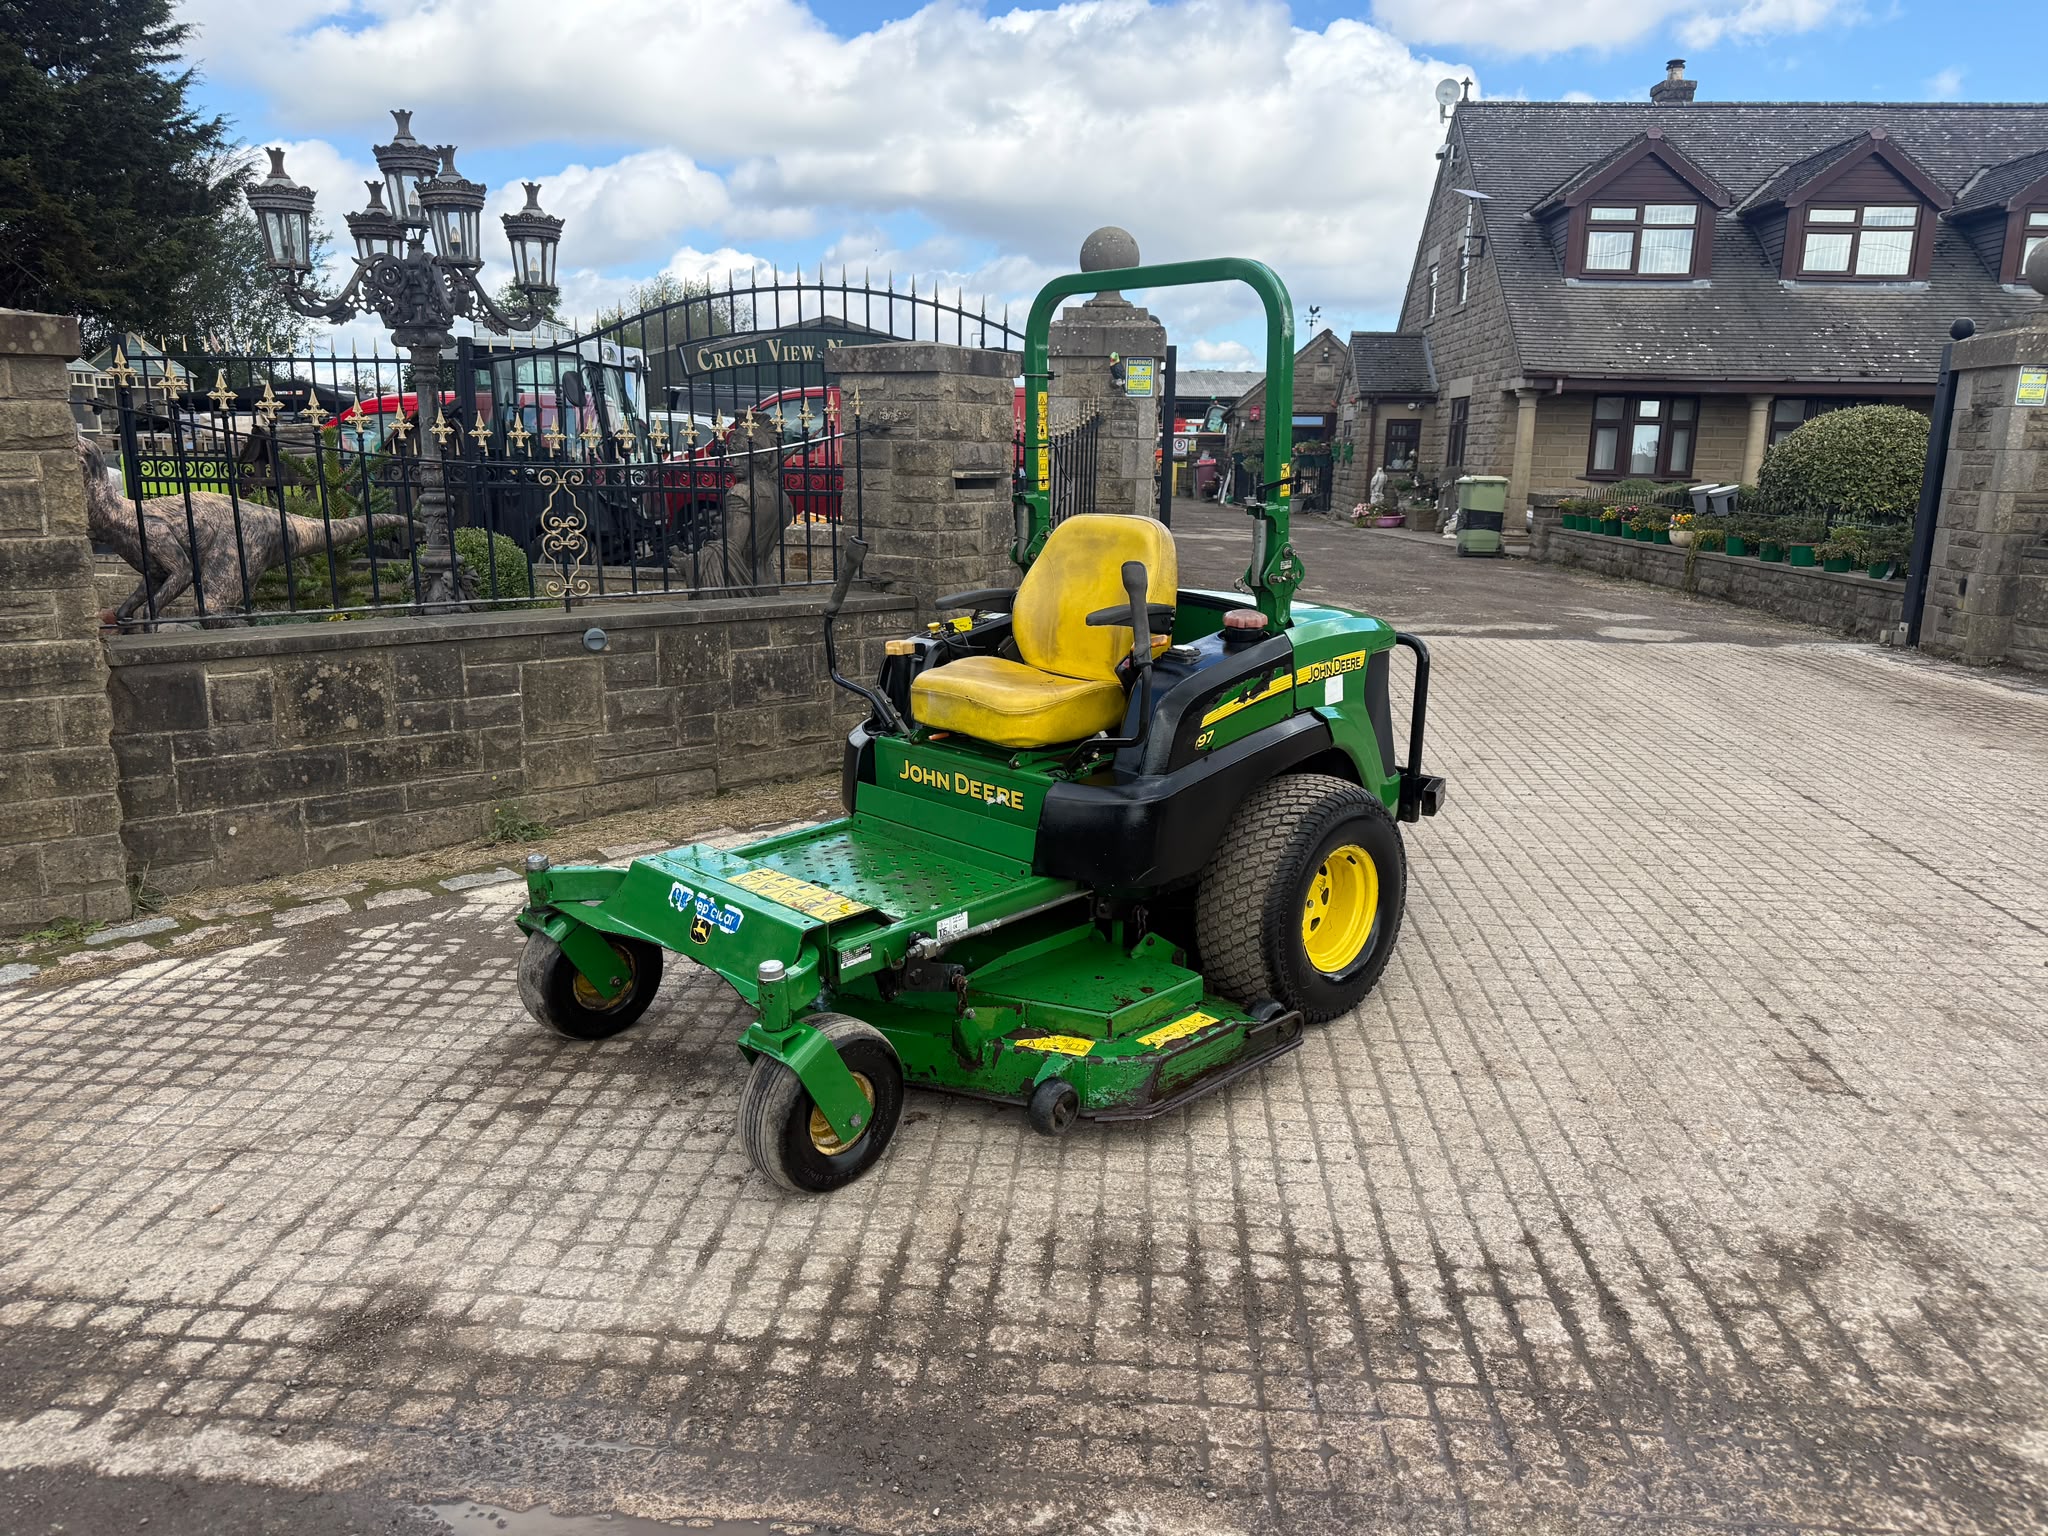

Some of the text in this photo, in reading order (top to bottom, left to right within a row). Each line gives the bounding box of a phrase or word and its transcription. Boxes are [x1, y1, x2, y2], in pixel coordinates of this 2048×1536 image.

[697, 347, 758, 372] CRICH
[765, 338, 816, 362] VIEW
[1308, 655, 1361, 683] JOHN DEERE
[1195, 729, 1215, 749] 97
[899, 759, 1025, 812] JOHN DEERE
